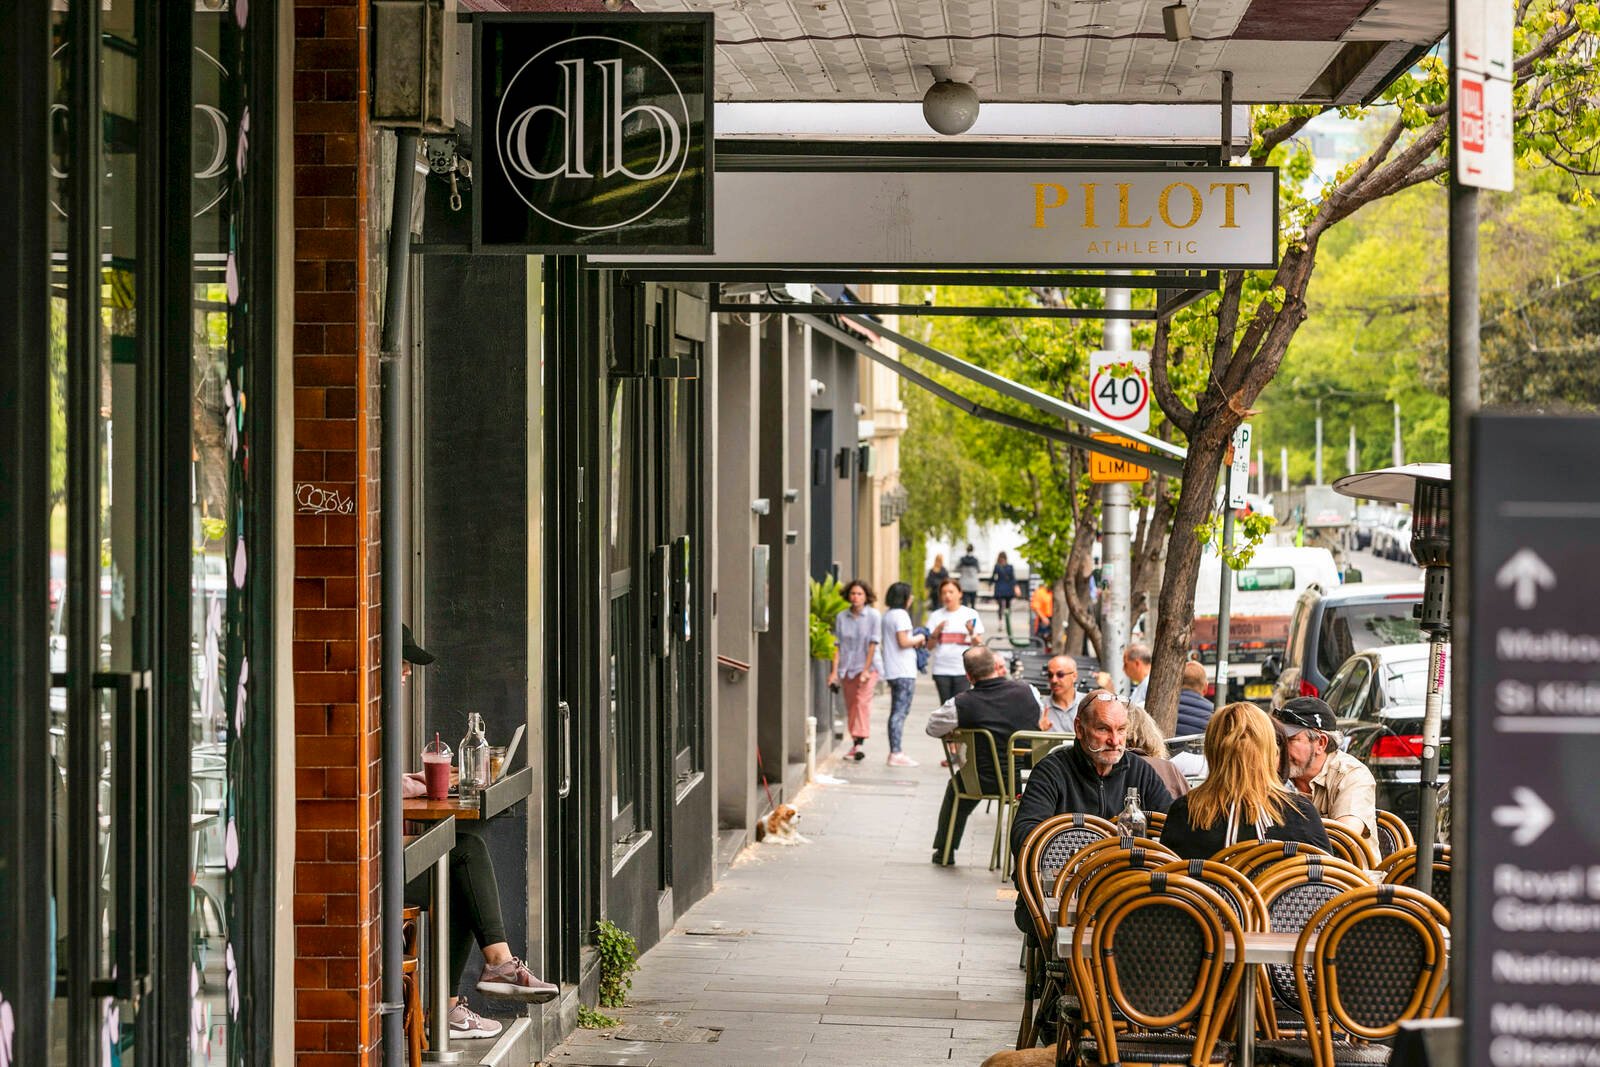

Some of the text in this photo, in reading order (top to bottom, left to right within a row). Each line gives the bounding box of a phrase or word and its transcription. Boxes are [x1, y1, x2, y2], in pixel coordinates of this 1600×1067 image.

[506, 57, 682, 181] db
[1029, 180, 1251, 230] PILOT
[1087, 240, 1198, 255] ATHLETIC
[1098, 377, 1141, 406] 40
[1539, 682, 1600, 713] Kild
